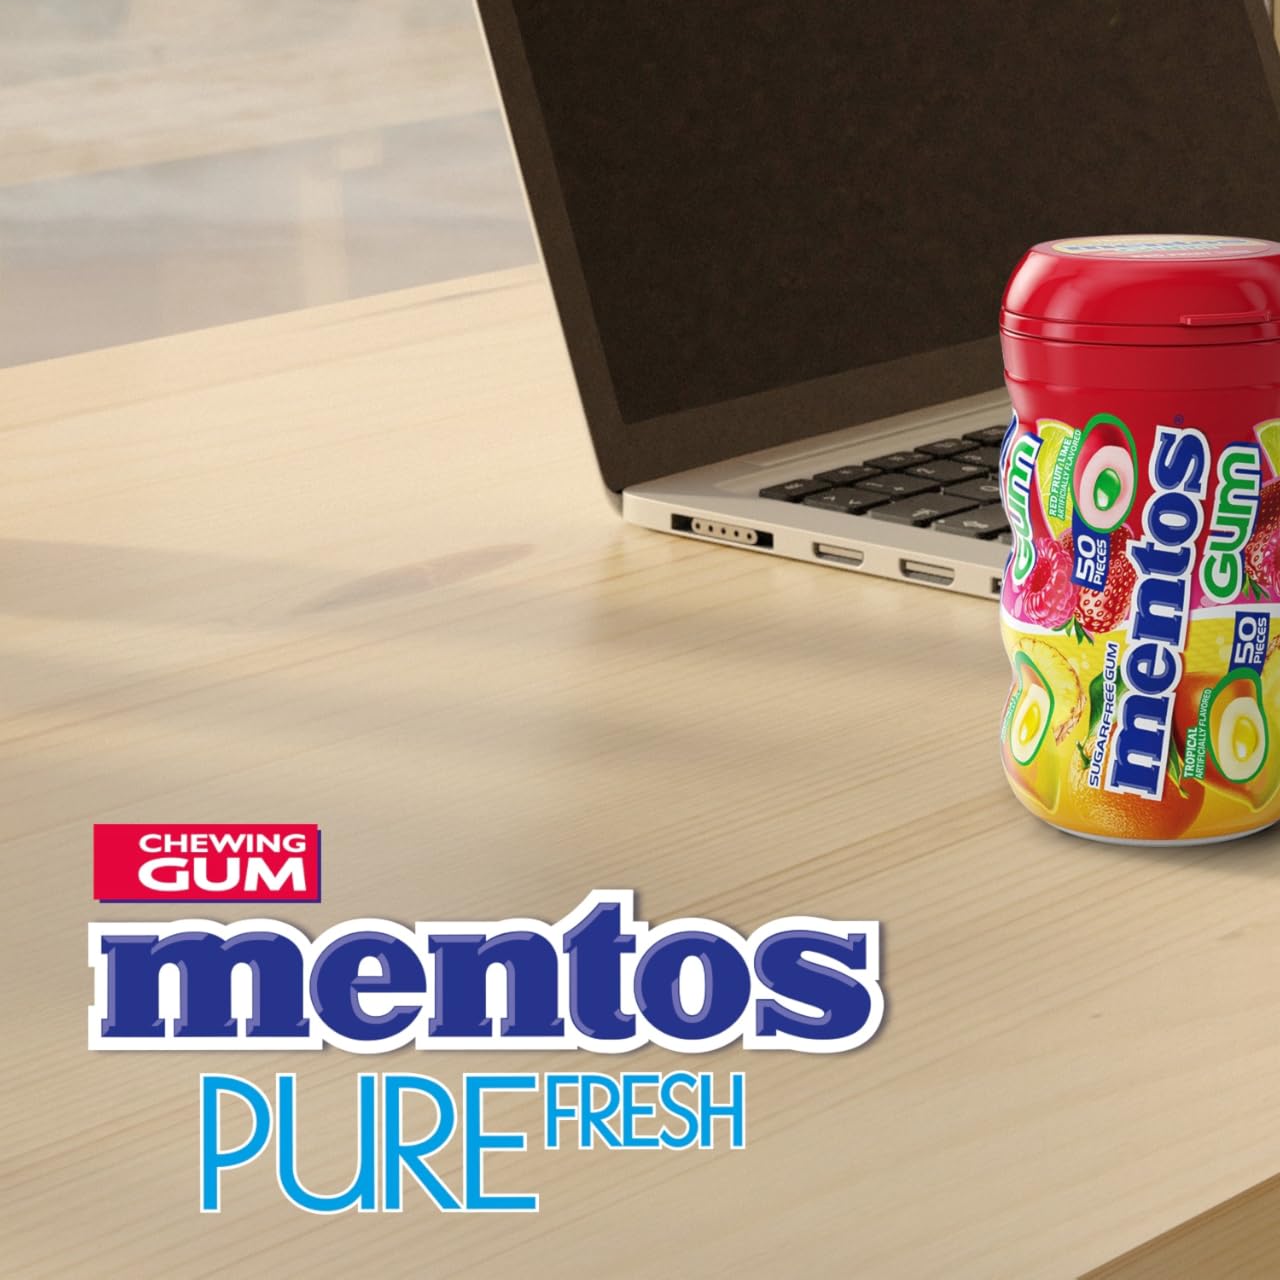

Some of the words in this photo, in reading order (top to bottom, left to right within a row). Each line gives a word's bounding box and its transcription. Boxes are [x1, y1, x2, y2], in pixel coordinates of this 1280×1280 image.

[1057, 470, 1070, 520] ARTIFICIALLY
[1064, 428, 1082, 470] FLAVORED
[1049, 495, 1058, 517] RED
[1075, 534, 1096, 583] 50
[1093, 538, 1107, 585] PIECES
[1105, 426, 1210, 799] mentos
[1234, 616, 1257, 664] 50
[1253, 617, 1267, 664] PIECES
[1198, 688, 1212, 727] FLAVORED
[1183, 727, 1198, 778] TROPICAL
[1195, 726, 1207, 779] ARTIFICIALLY
